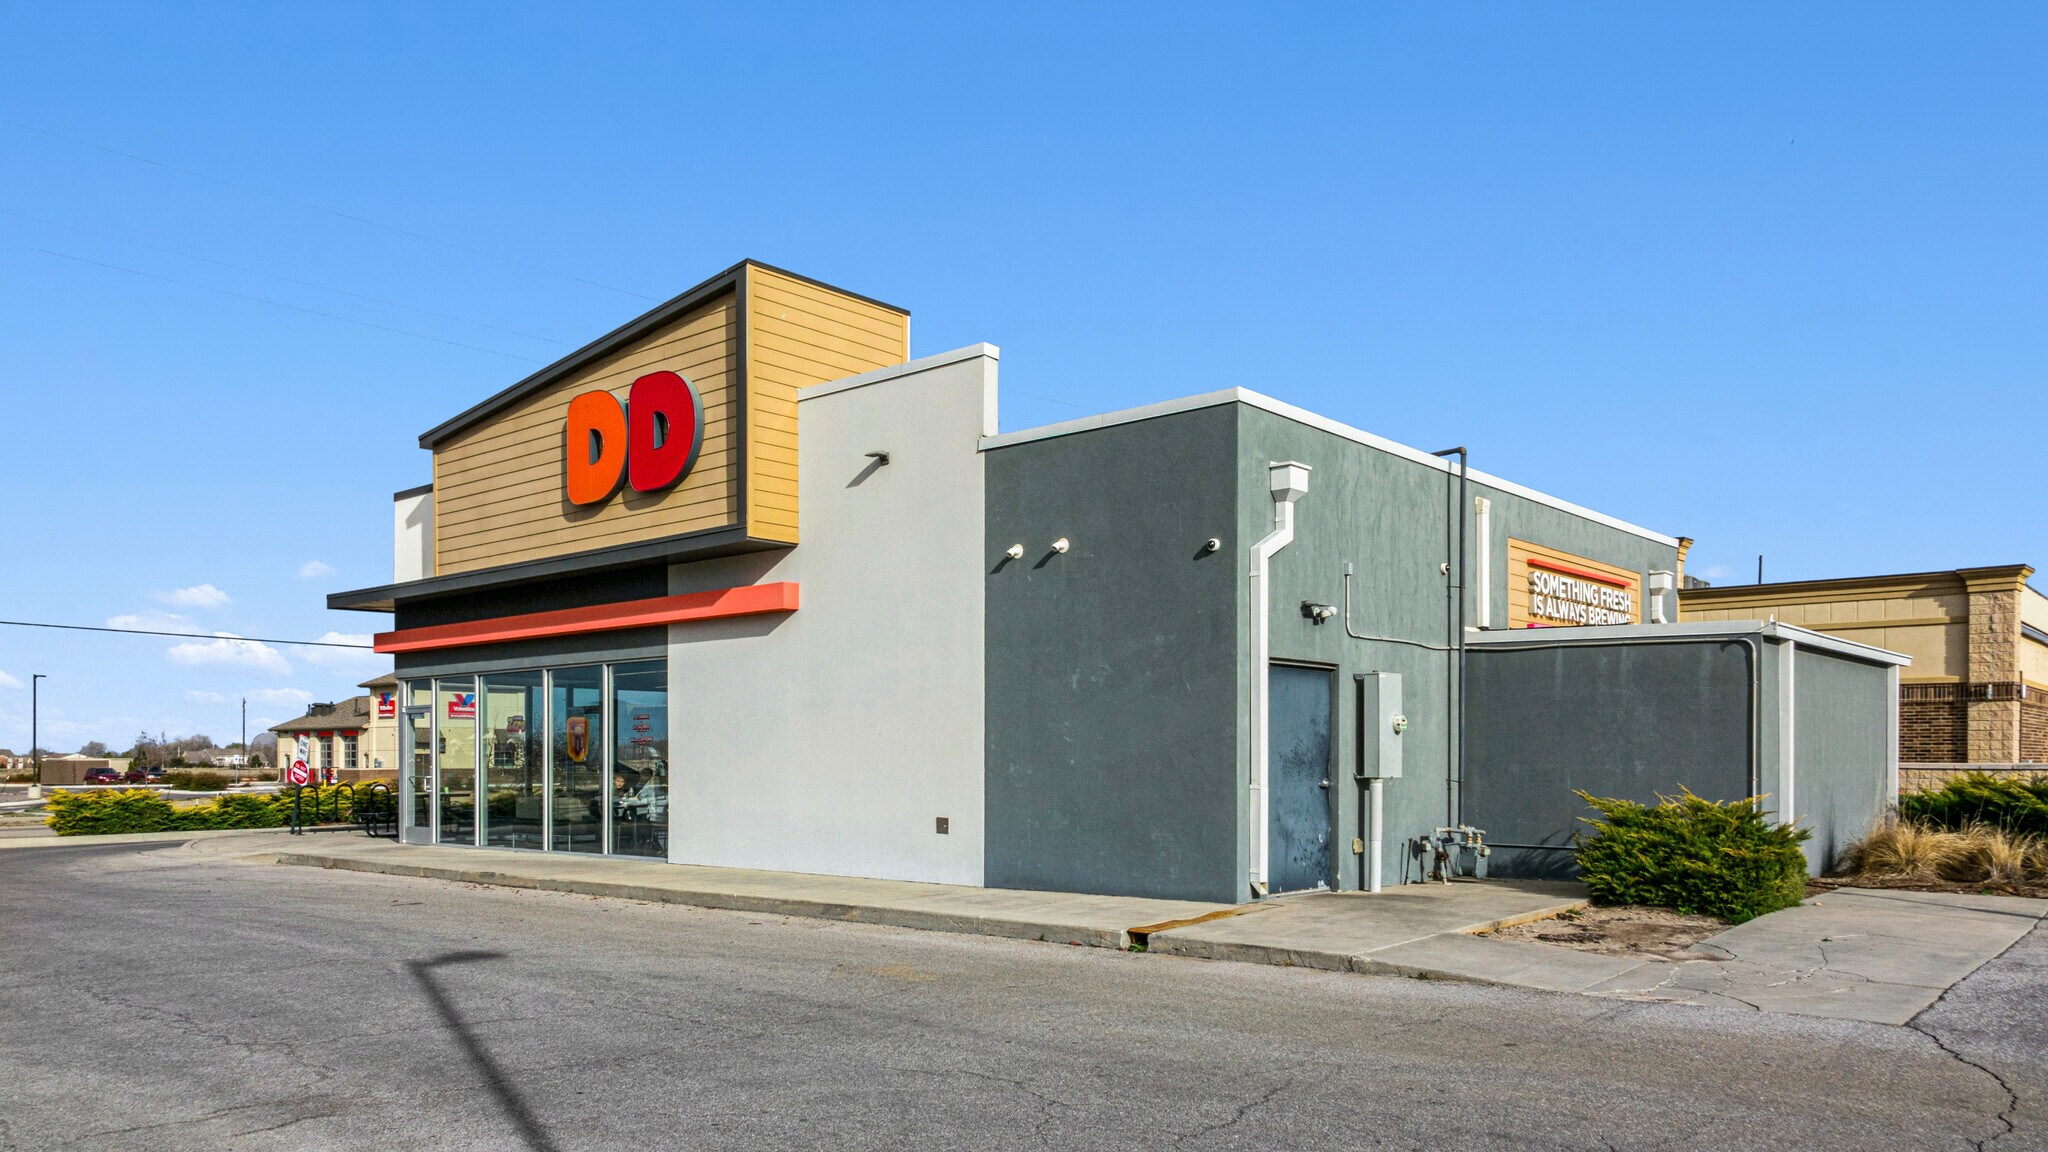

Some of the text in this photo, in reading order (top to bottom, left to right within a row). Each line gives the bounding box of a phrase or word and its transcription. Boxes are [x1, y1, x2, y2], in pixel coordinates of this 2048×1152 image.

[567, 370, 704, 505] DD
[1532, 571, 1631, 612] SOMETHING FRESH
[1533, 594, 1544, 615] IS
[1546, 599, 1587, 623] ALWAYS
